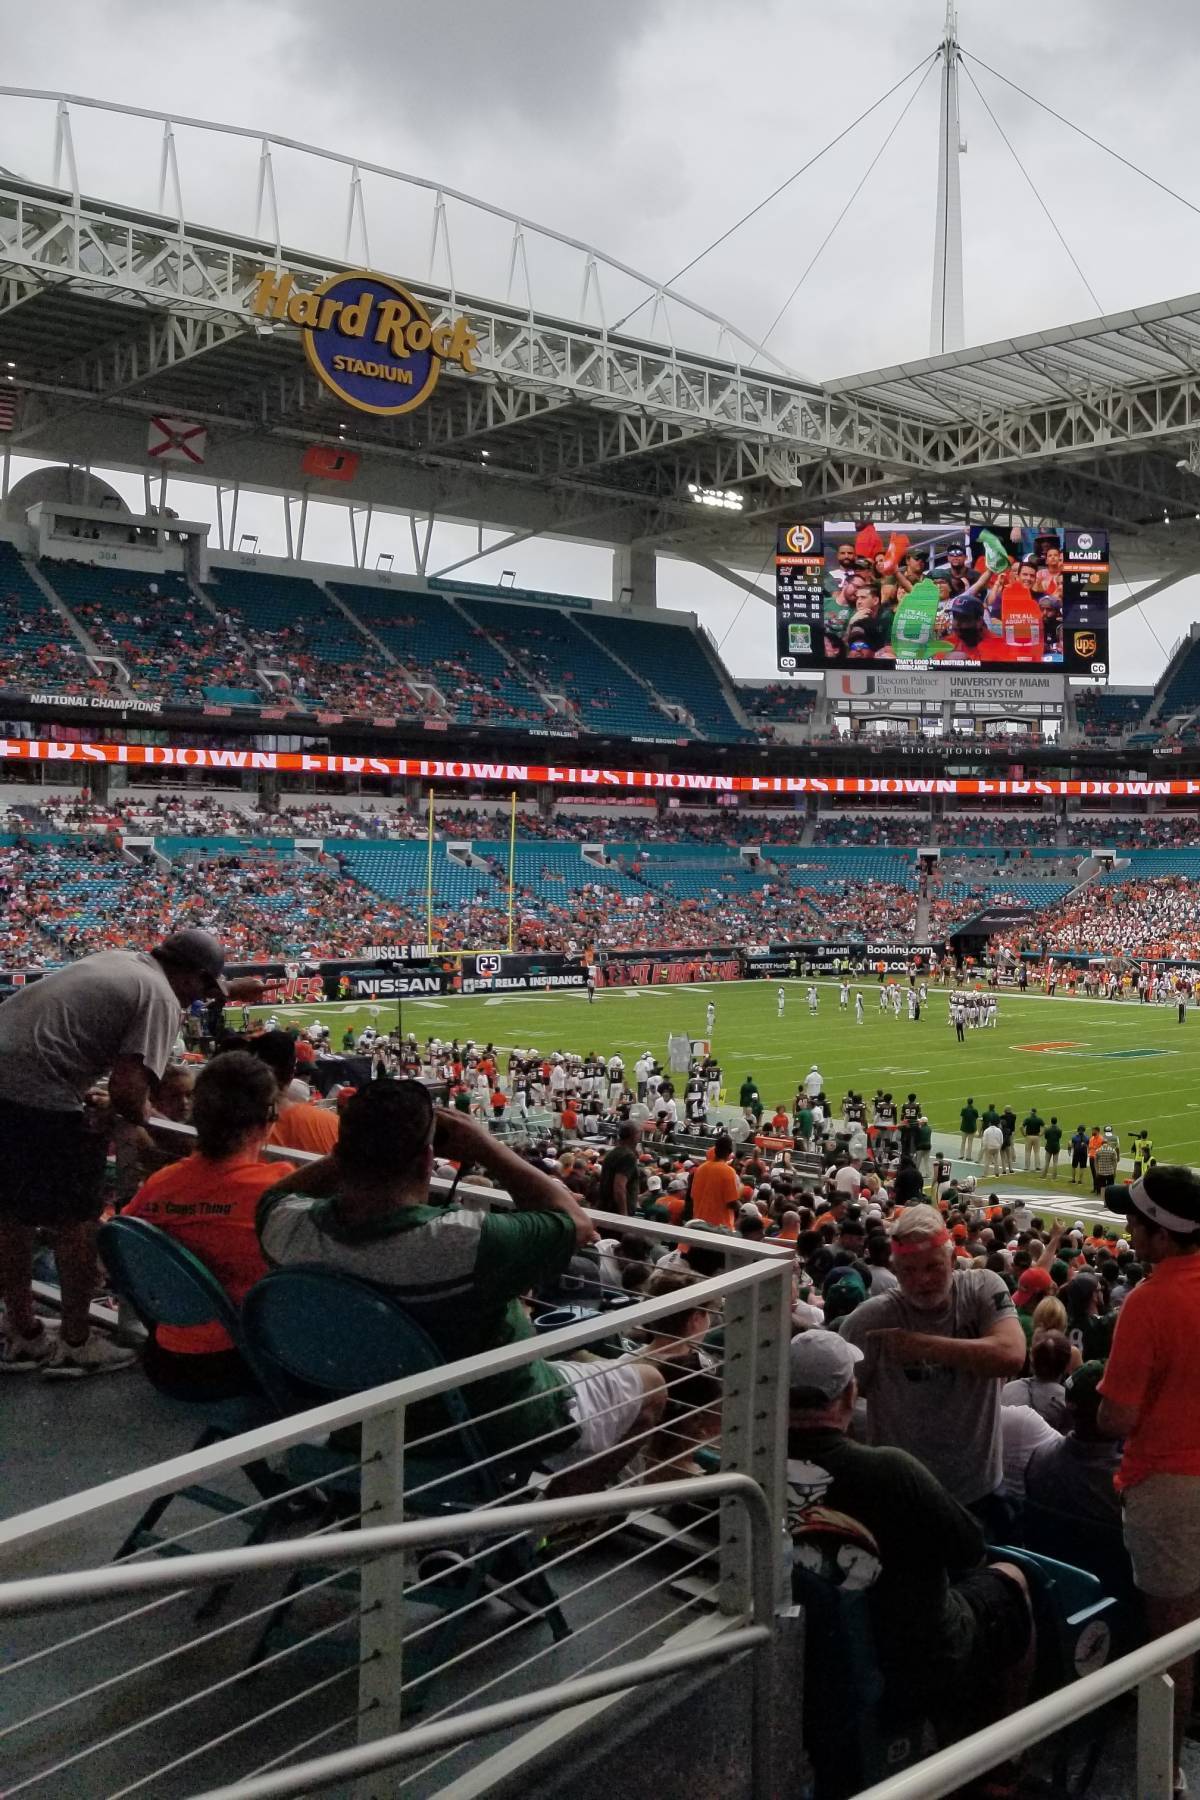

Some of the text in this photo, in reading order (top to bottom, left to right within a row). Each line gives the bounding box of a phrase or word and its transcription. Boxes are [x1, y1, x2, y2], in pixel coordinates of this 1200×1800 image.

[251, 269, 478, 373] Hard Rock
[333, 355, 413, 385] STADIUM
[1076, 639, 1096, 653] ups
[1092, 664, 1104, 672] CC
[910, 676, 938, 686] Palmer
[950, 677, 1050, 688] UNIVERSITY OF MIAMI
[950, 688, 1023, 698] HEALTH SYSTEM
[30, 693, 162, 713] NATIONAL CHAMPIONS
[144, 747, 278, 769] DOWN
[945, 747, 991, 755] HONOR
[420, 761, 528, 780] DOWN
[650, 773, 733, 790] DOWN
[857, 779, 957, 793] DOWN
[1081, 781, 1171, 794] DOWN
[362, 945, 409, 960] MUSCLE
[867, 945, 933, 956] Booking.com
[480, 957, 499, 970] 25
[358, 977, 441, 995] NISSAN
